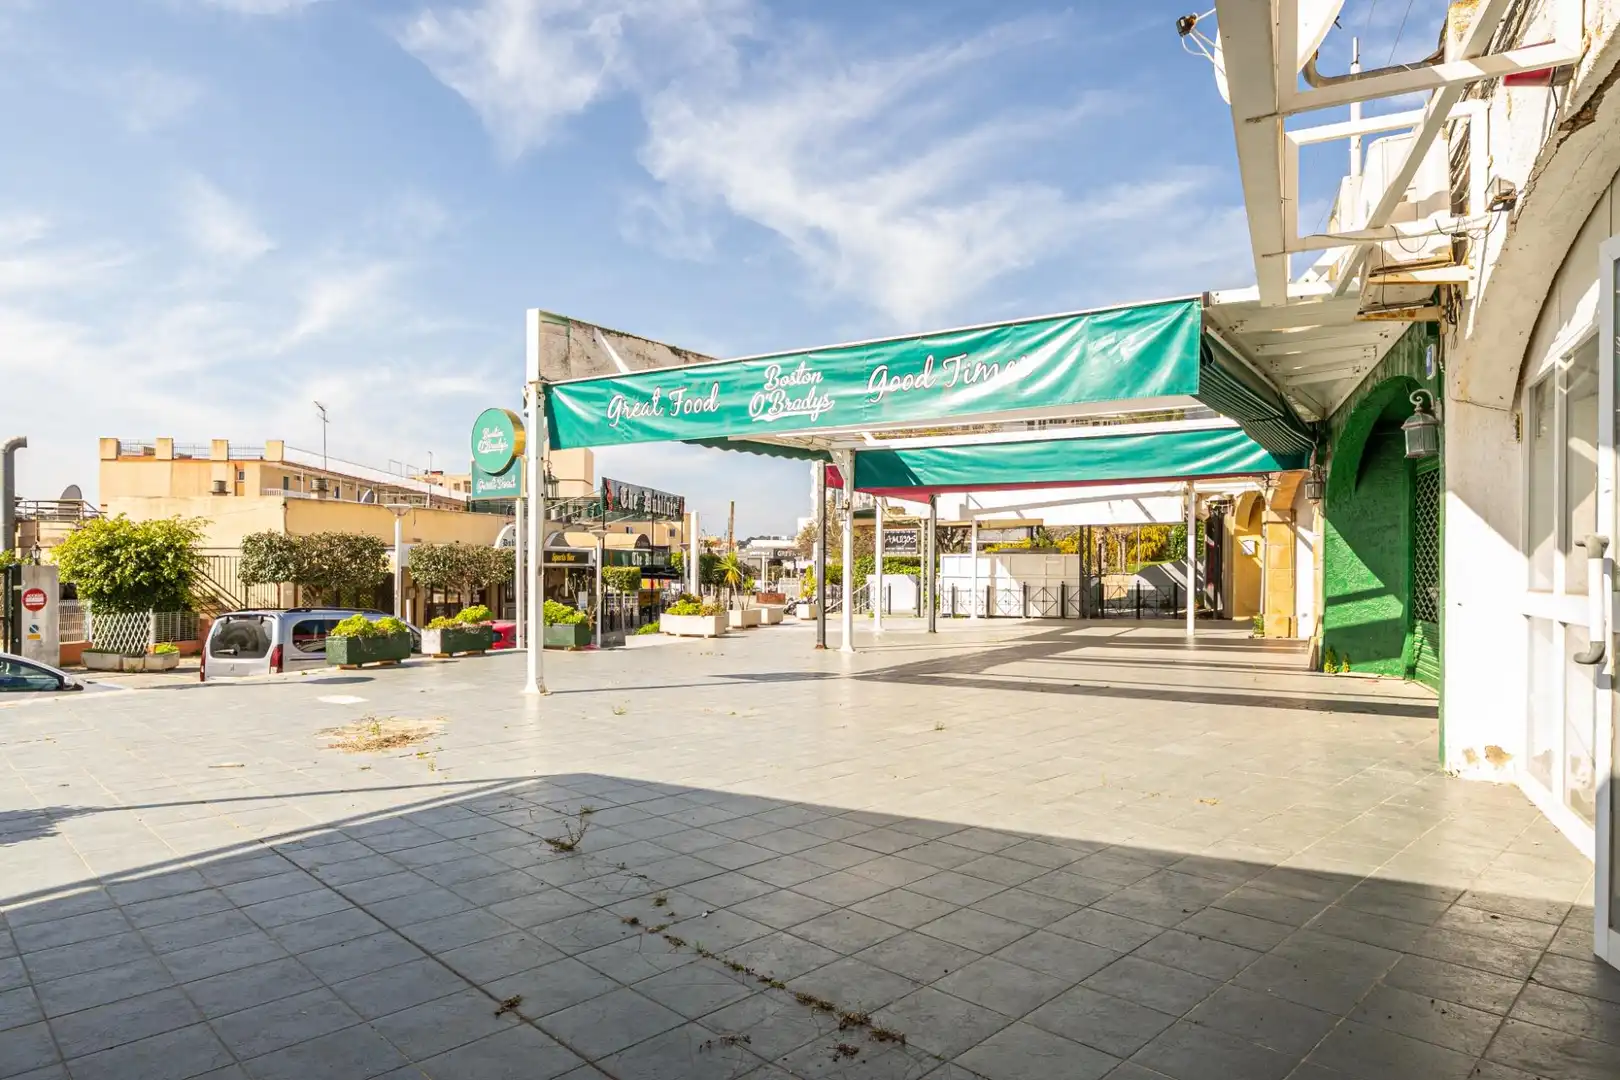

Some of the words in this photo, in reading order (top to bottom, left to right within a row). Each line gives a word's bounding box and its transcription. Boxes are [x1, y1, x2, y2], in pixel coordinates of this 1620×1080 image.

[764, 360, 824, 391] Boston
[866, 355, 937, 403] Good
[607, 385, 664, 428] Great
[668, 381, 720, 417] Food
[749, 386, 836, 422] O'Bradys
[620, 486, 638, 511] The
